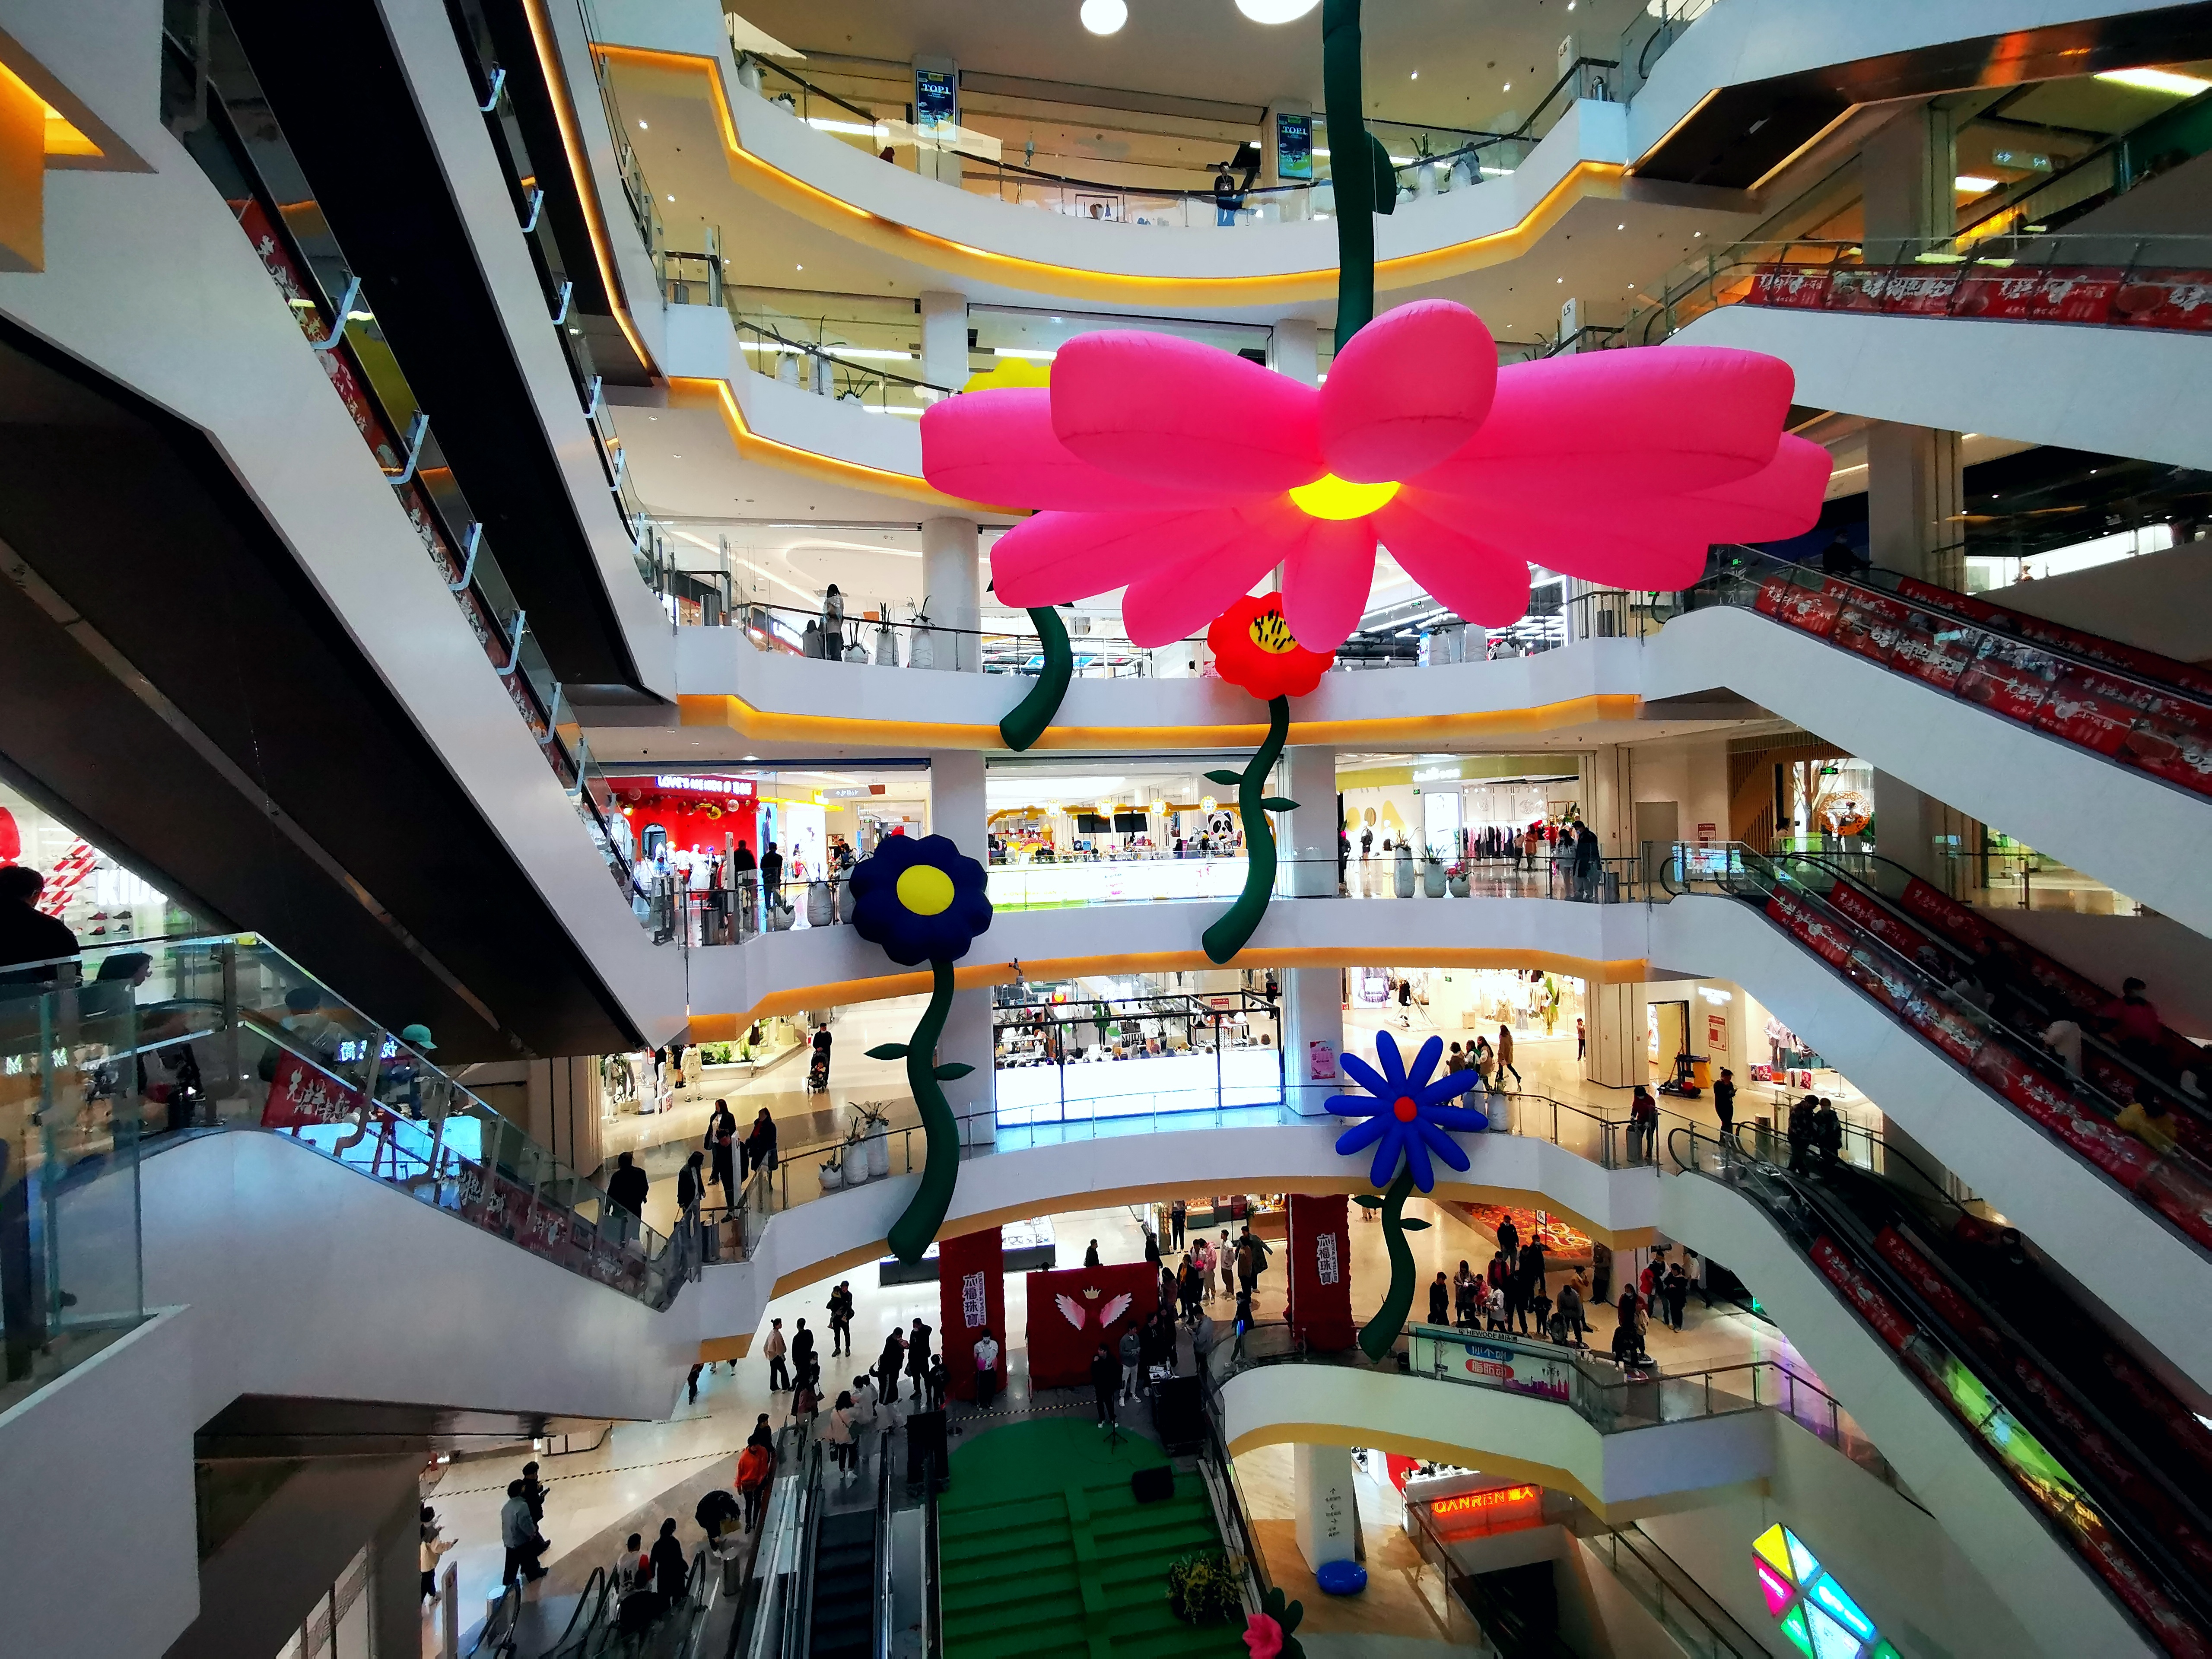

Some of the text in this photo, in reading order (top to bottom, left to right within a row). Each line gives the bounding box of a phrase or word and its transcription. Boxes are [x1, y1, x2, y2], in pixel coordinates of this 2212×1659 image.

[922, 83, 949, 93] TOP1
[1283, 126, 1306, 135] TOP1
[1434, 1491, 1505, 1513] QANREN
